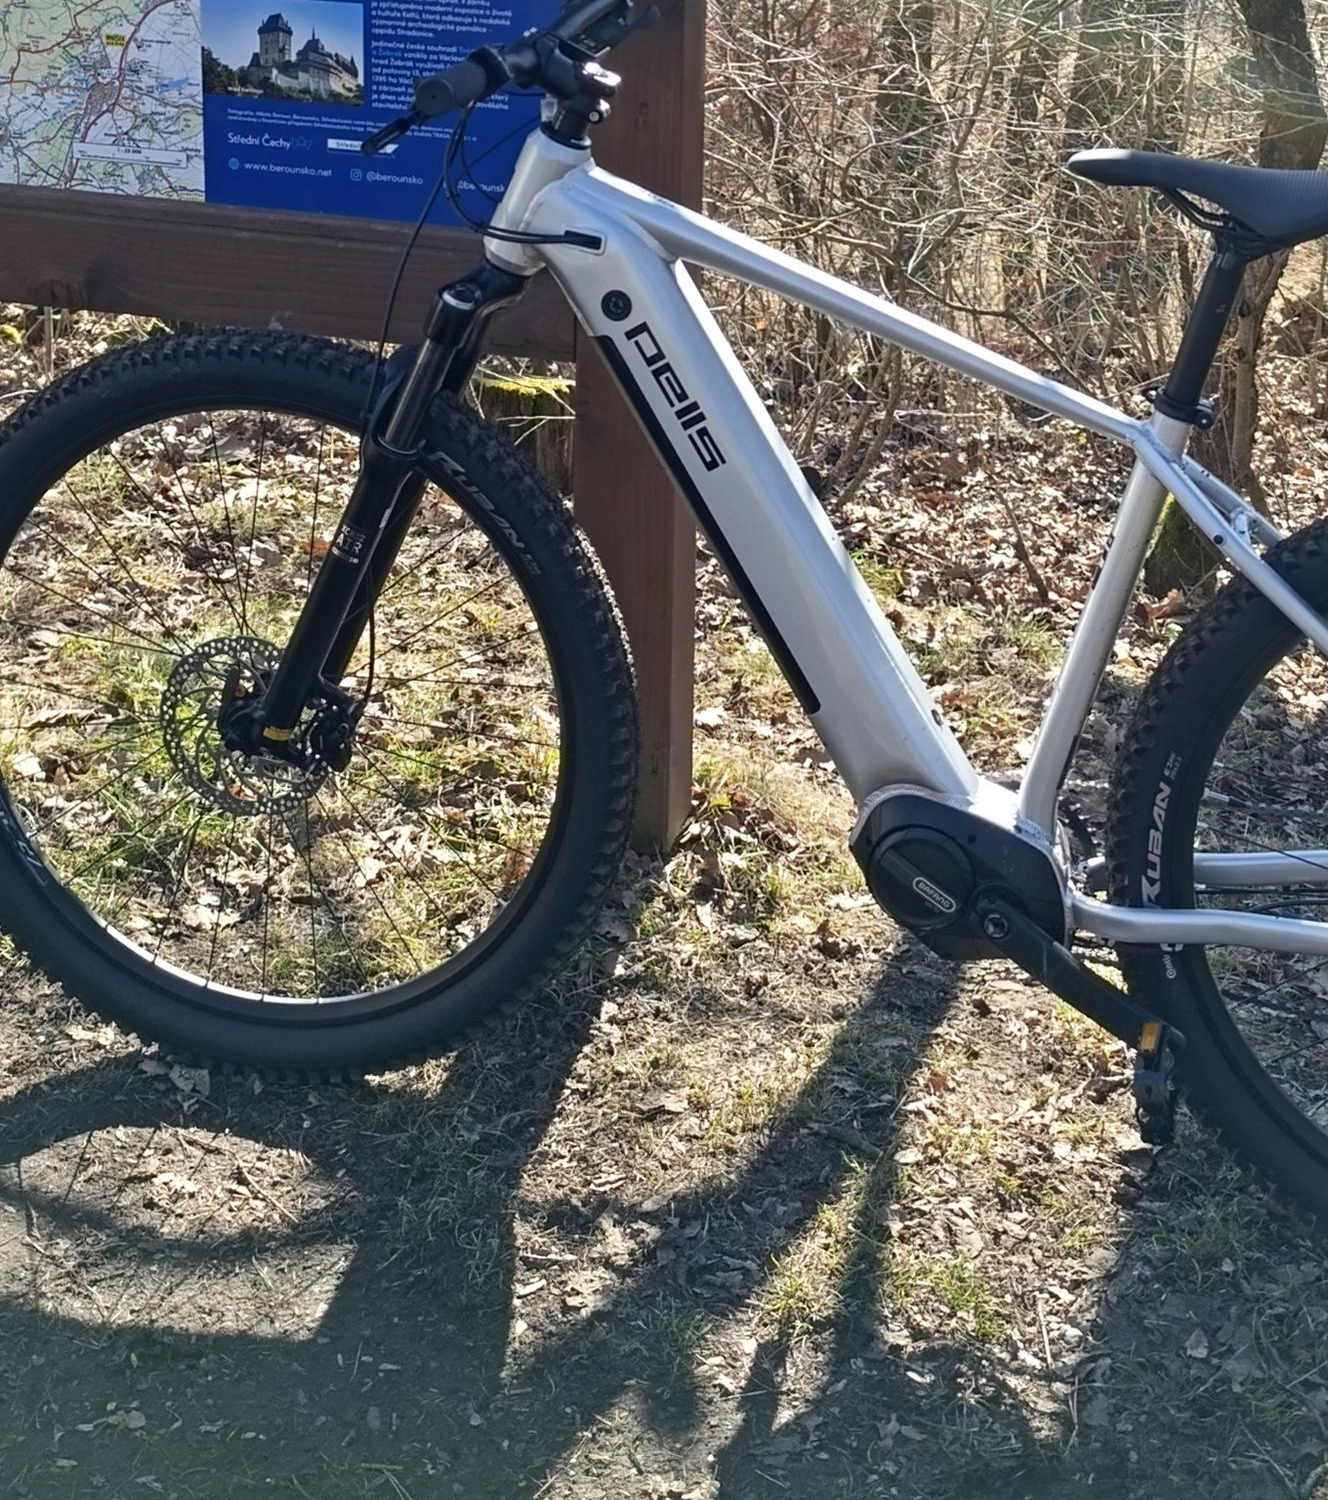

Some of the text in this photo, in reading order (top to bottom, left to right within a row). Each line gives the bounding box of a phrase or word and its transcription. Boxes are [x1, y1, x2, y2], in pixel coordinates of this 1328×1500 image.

[228, 132, 291, 150] Střední Čechy
[244, 162, 332, 177] www.berounsko.net
[367, 172, 423, 185] @berounsko
[624, 321, 726, 472] pells
[336, 533, 362, 554] AIR
[918, 882, 951, 908] BAFANG
